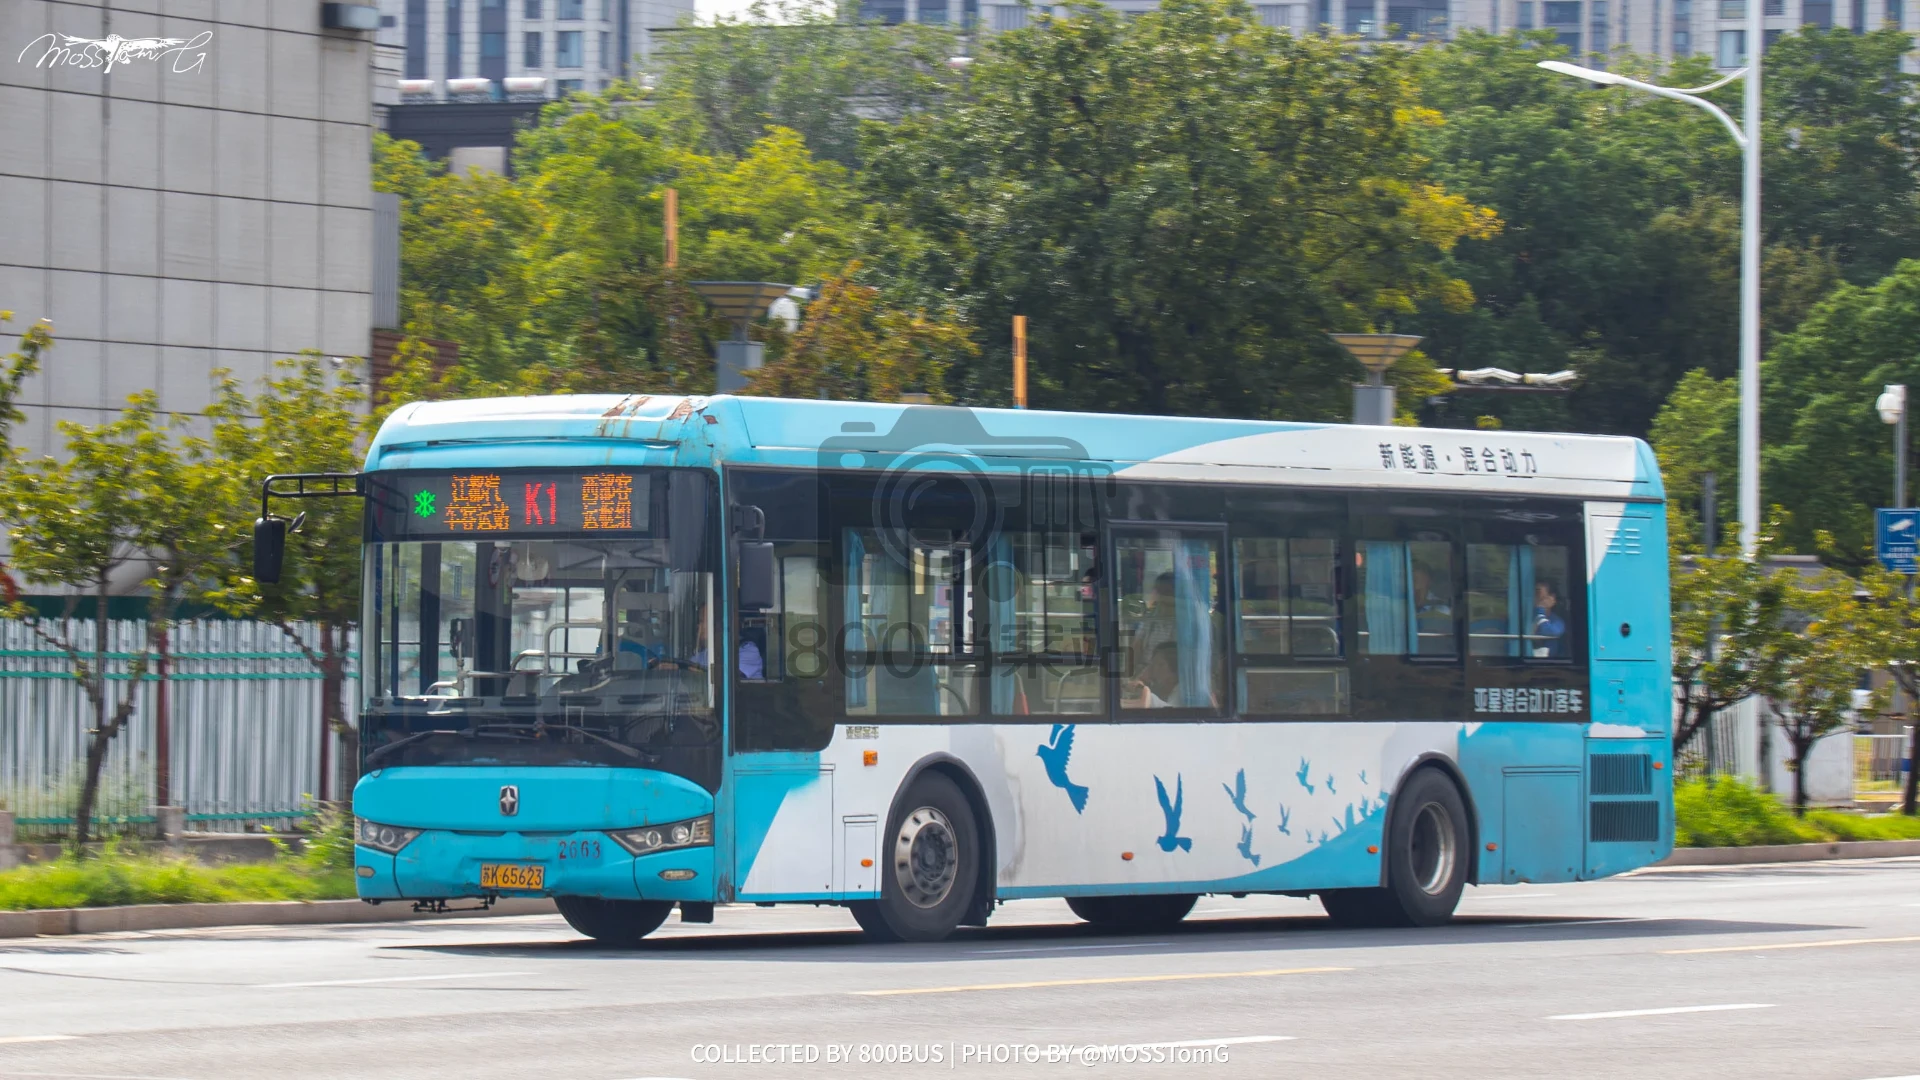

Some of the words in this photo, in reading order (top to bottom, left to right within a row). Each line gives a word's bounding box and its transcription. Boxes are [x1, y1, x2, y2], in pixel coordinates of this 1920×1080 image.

[451, 473, 502, 503] 江都汽
[582, 473, 633, 501] 西部客
[444, 502, 510, 530] 车客运站
[525, 482, 556, 525] K1
[1474, 688, 1583, 713] 亚星混合动力客车
[559, 840, 600, 859] 2663
